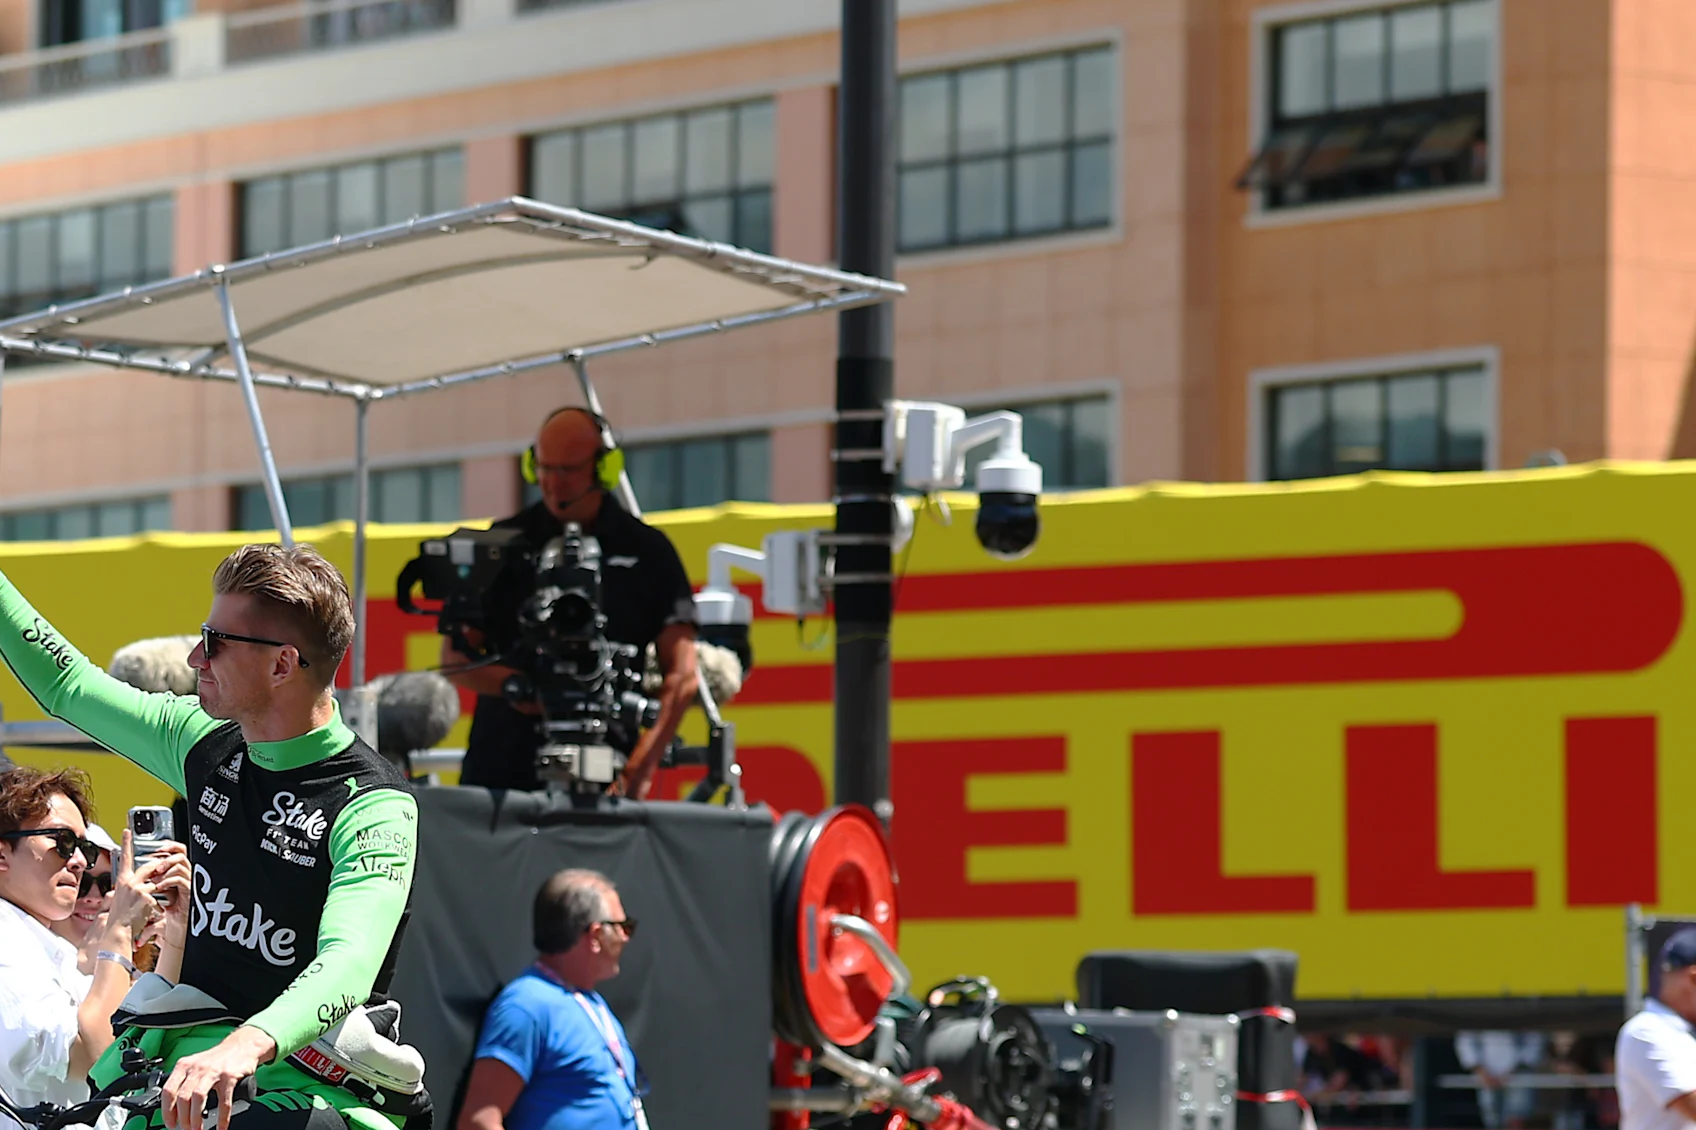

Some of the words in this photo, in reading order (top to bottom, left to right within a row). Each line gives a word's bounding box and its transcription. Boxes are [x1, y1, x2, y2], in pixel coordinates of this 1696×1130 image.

[22, 617, 73, 670] Stake
[261, 791, 327, 840] Stake
[192, 824, 217, 854] PicPay
[281, 849, 316, 867] SAUBER
[357, 841, 410, 861] WORKWE
[191, 863, 297, 967] Stake
[317, 994, 357, 1036] Stake
